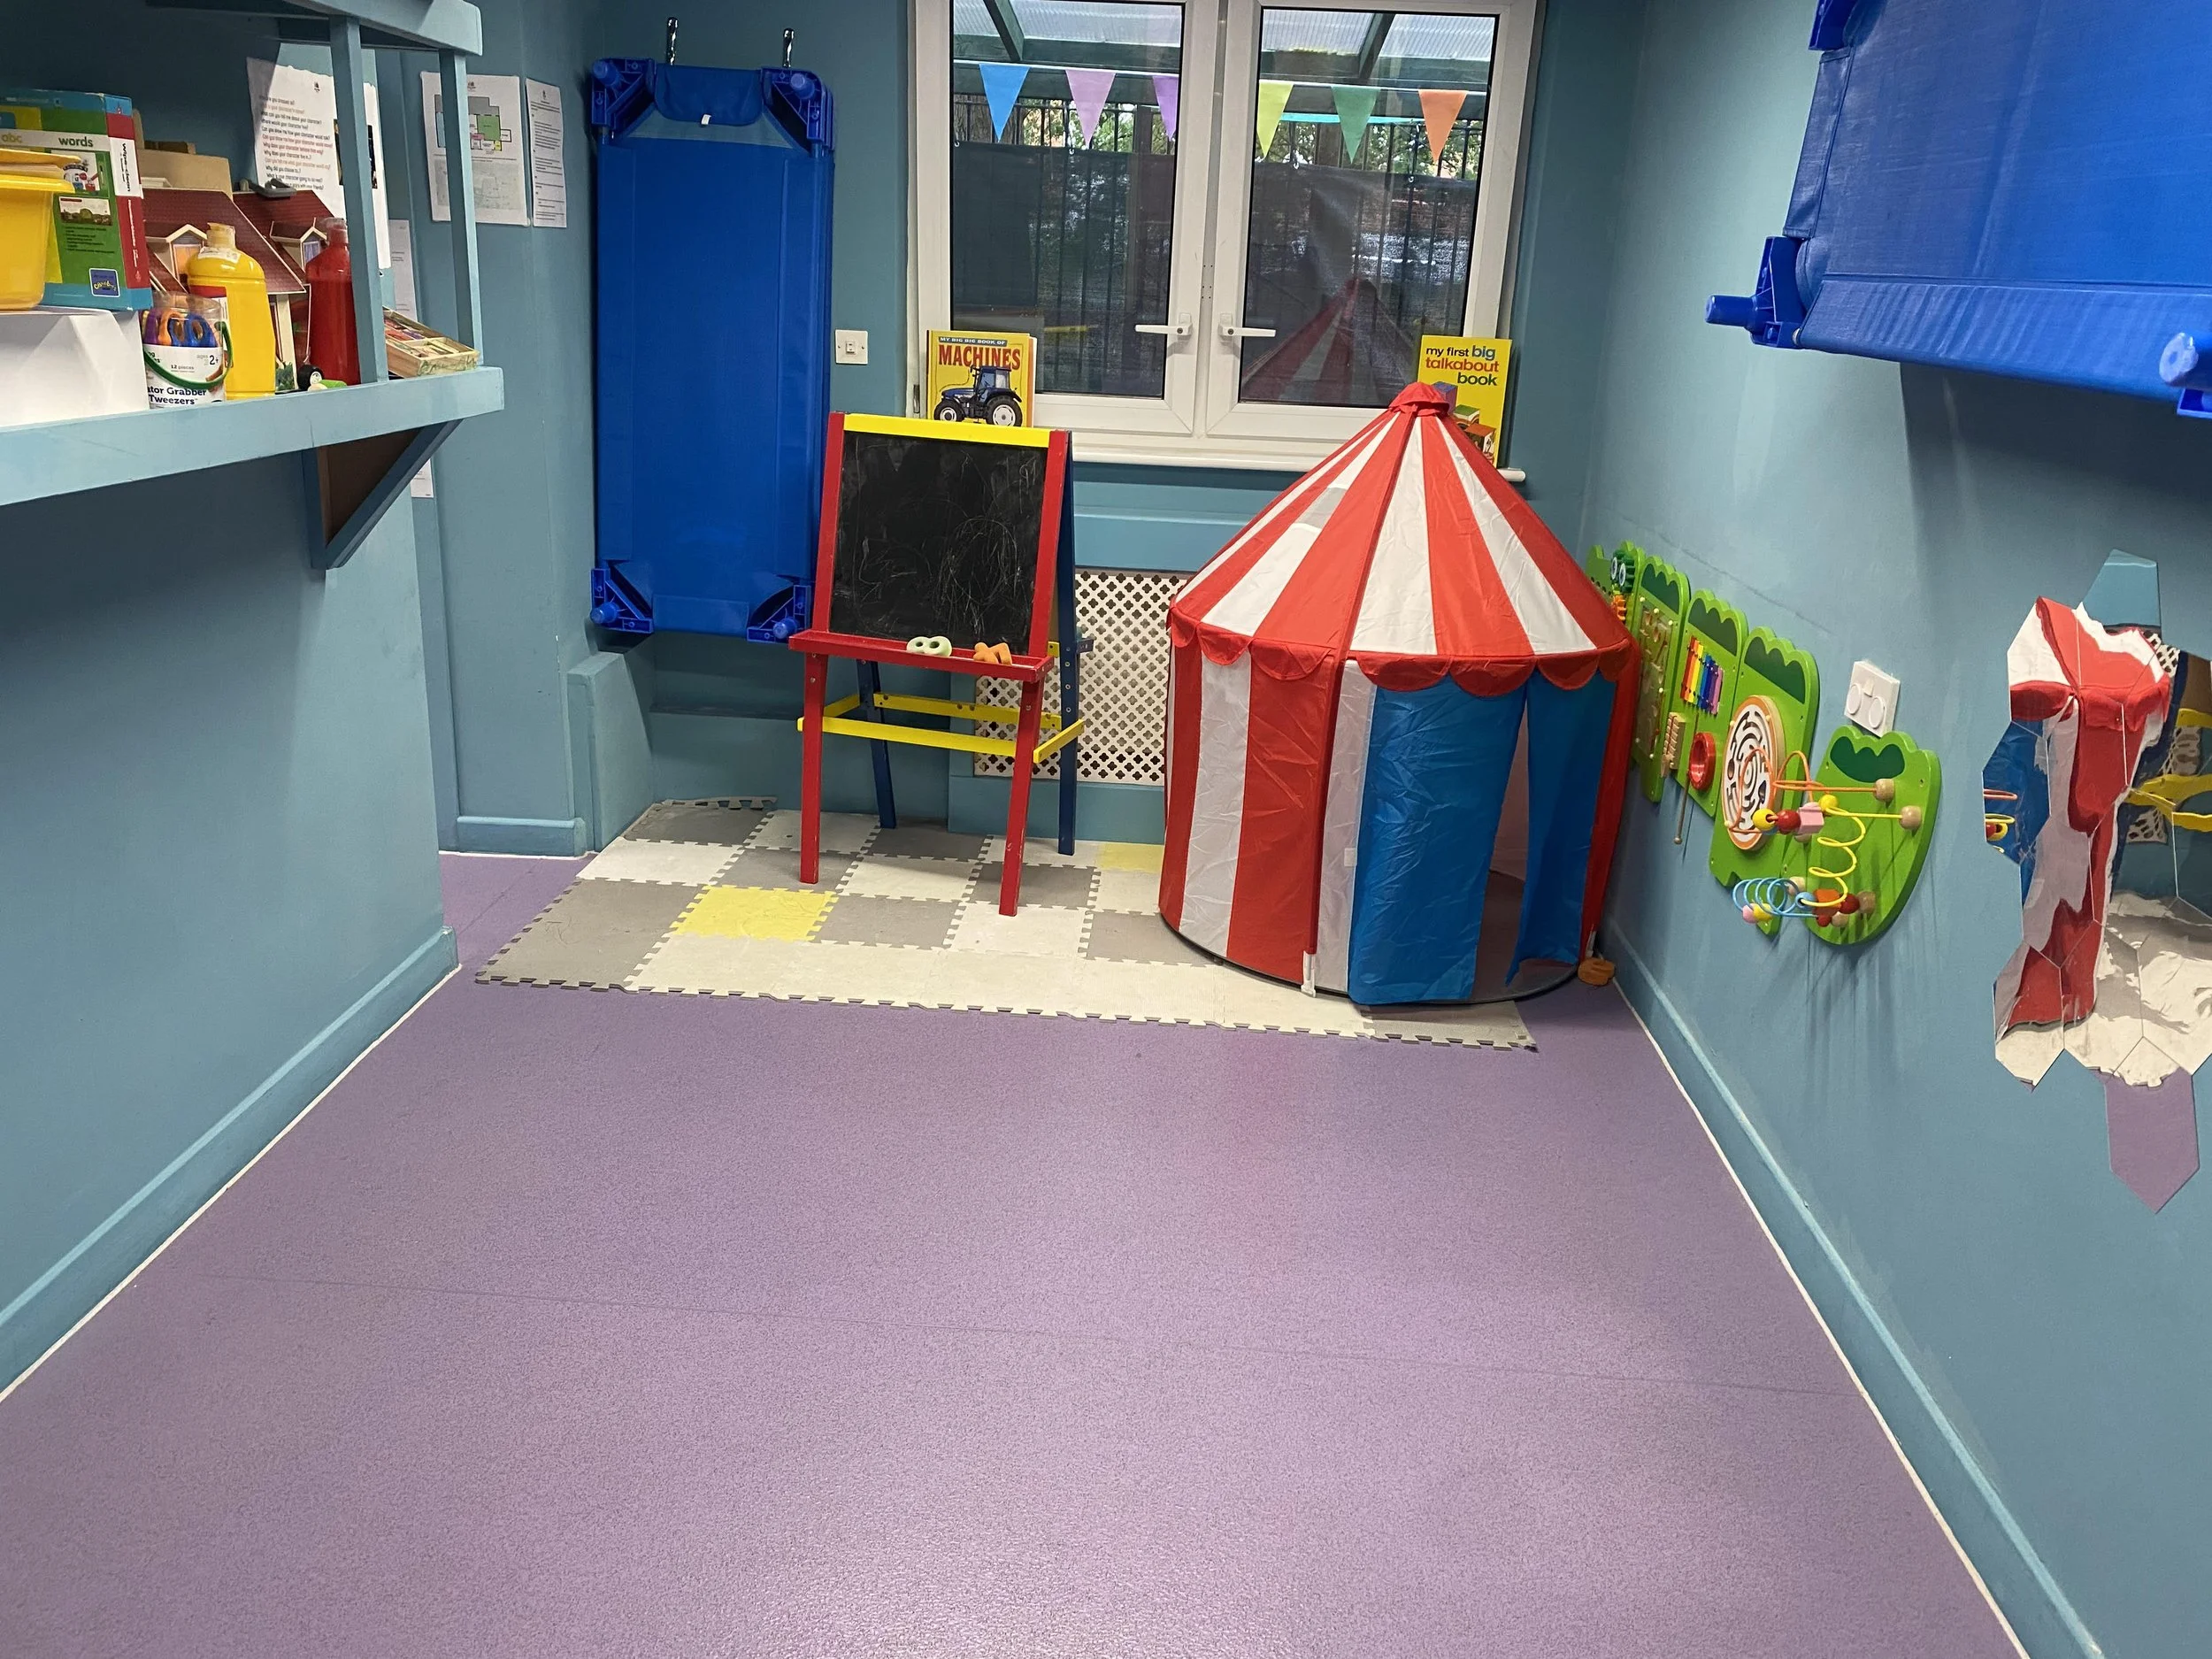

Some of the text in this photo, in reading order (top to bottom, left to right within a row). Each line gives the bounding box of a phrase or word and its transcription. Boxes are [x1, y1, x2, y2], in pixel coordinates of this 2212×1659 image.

[58, 136, 93, 148] words
[939, 345, 1020, 370] MACHINES
[1426, 345, 1496, 360] my first big
[1425, 357, 1499, 372] talkabout
[1457, 372, 1497, 386] book
[167, 387, 206, 396] Grabber
